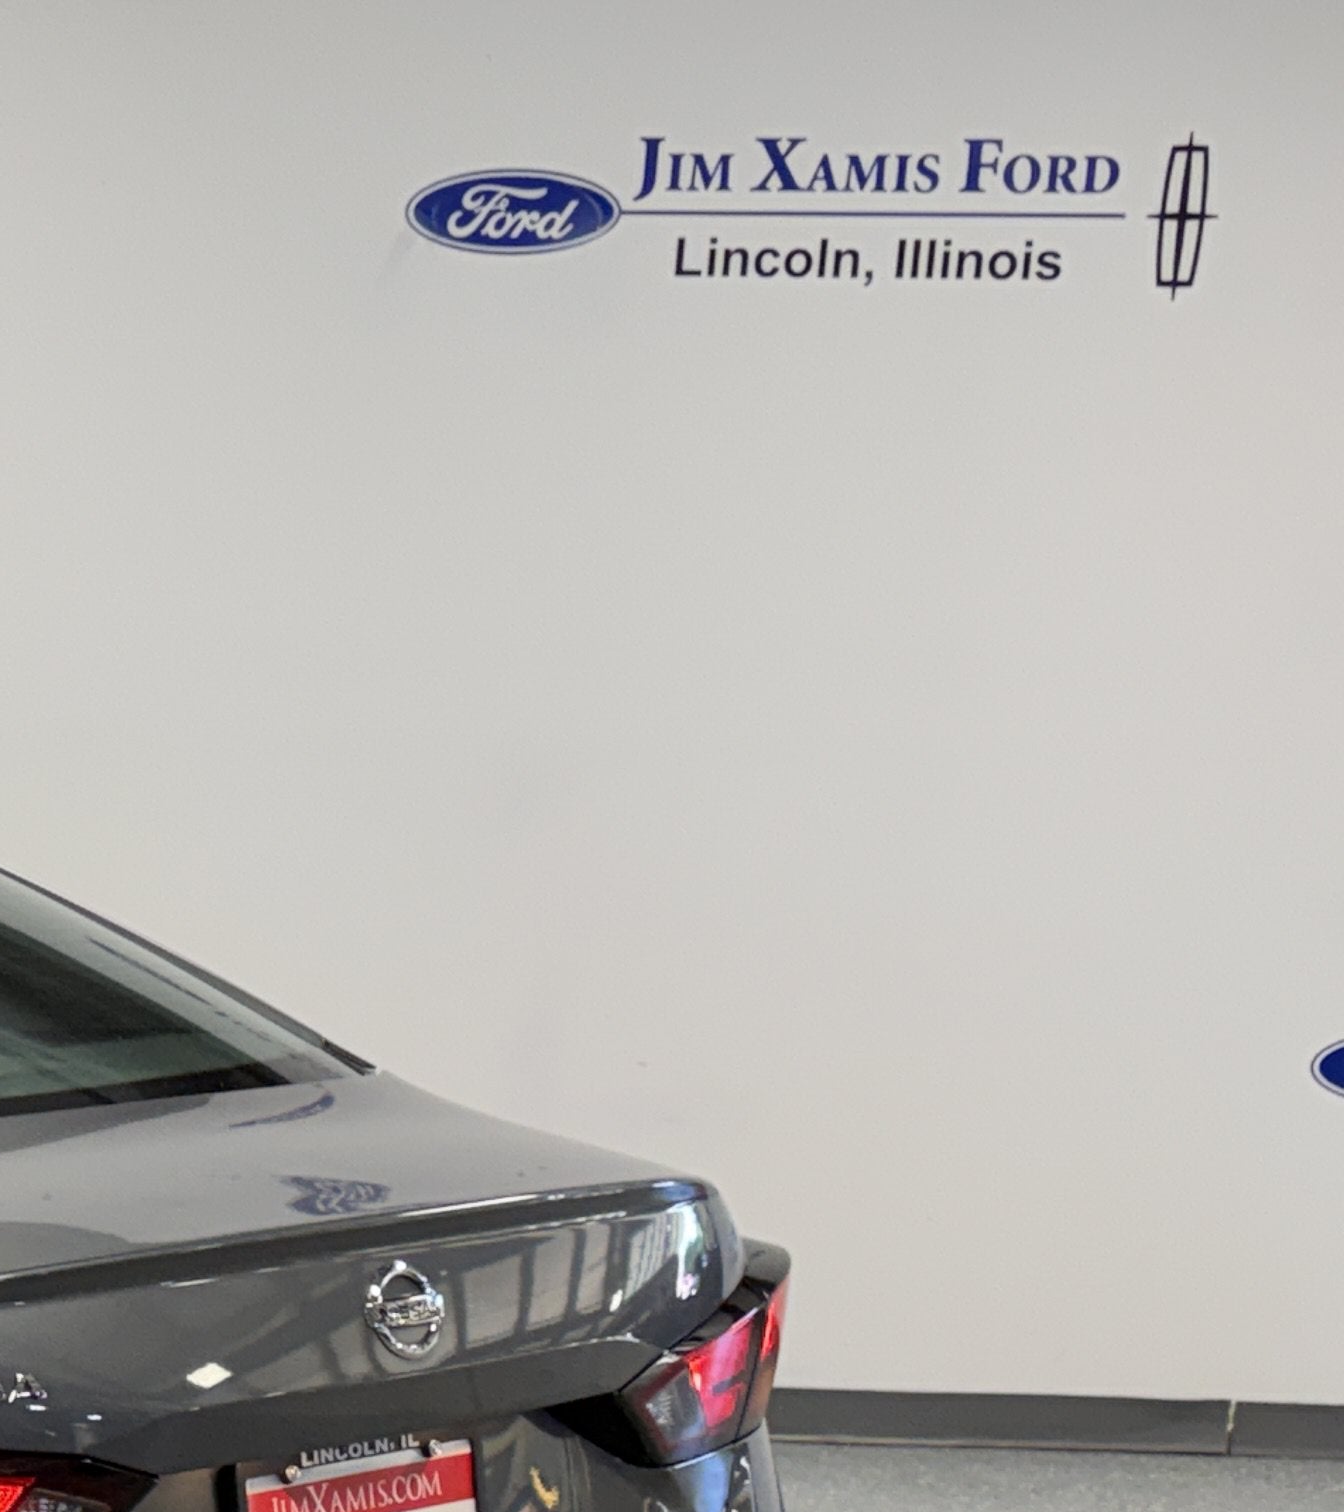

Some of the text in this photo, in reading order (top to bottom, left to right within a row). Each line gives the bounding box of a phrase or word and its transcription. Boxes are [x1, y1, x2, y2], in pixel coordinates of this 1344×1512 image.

[631, 136, 1121, 200] JIM XAMIS FORD
[446, 182, 580, 239] Ford
[674, 237, 1063, 285] Lincoln, Illinois
[400, 1432, 421, 1449] IL
